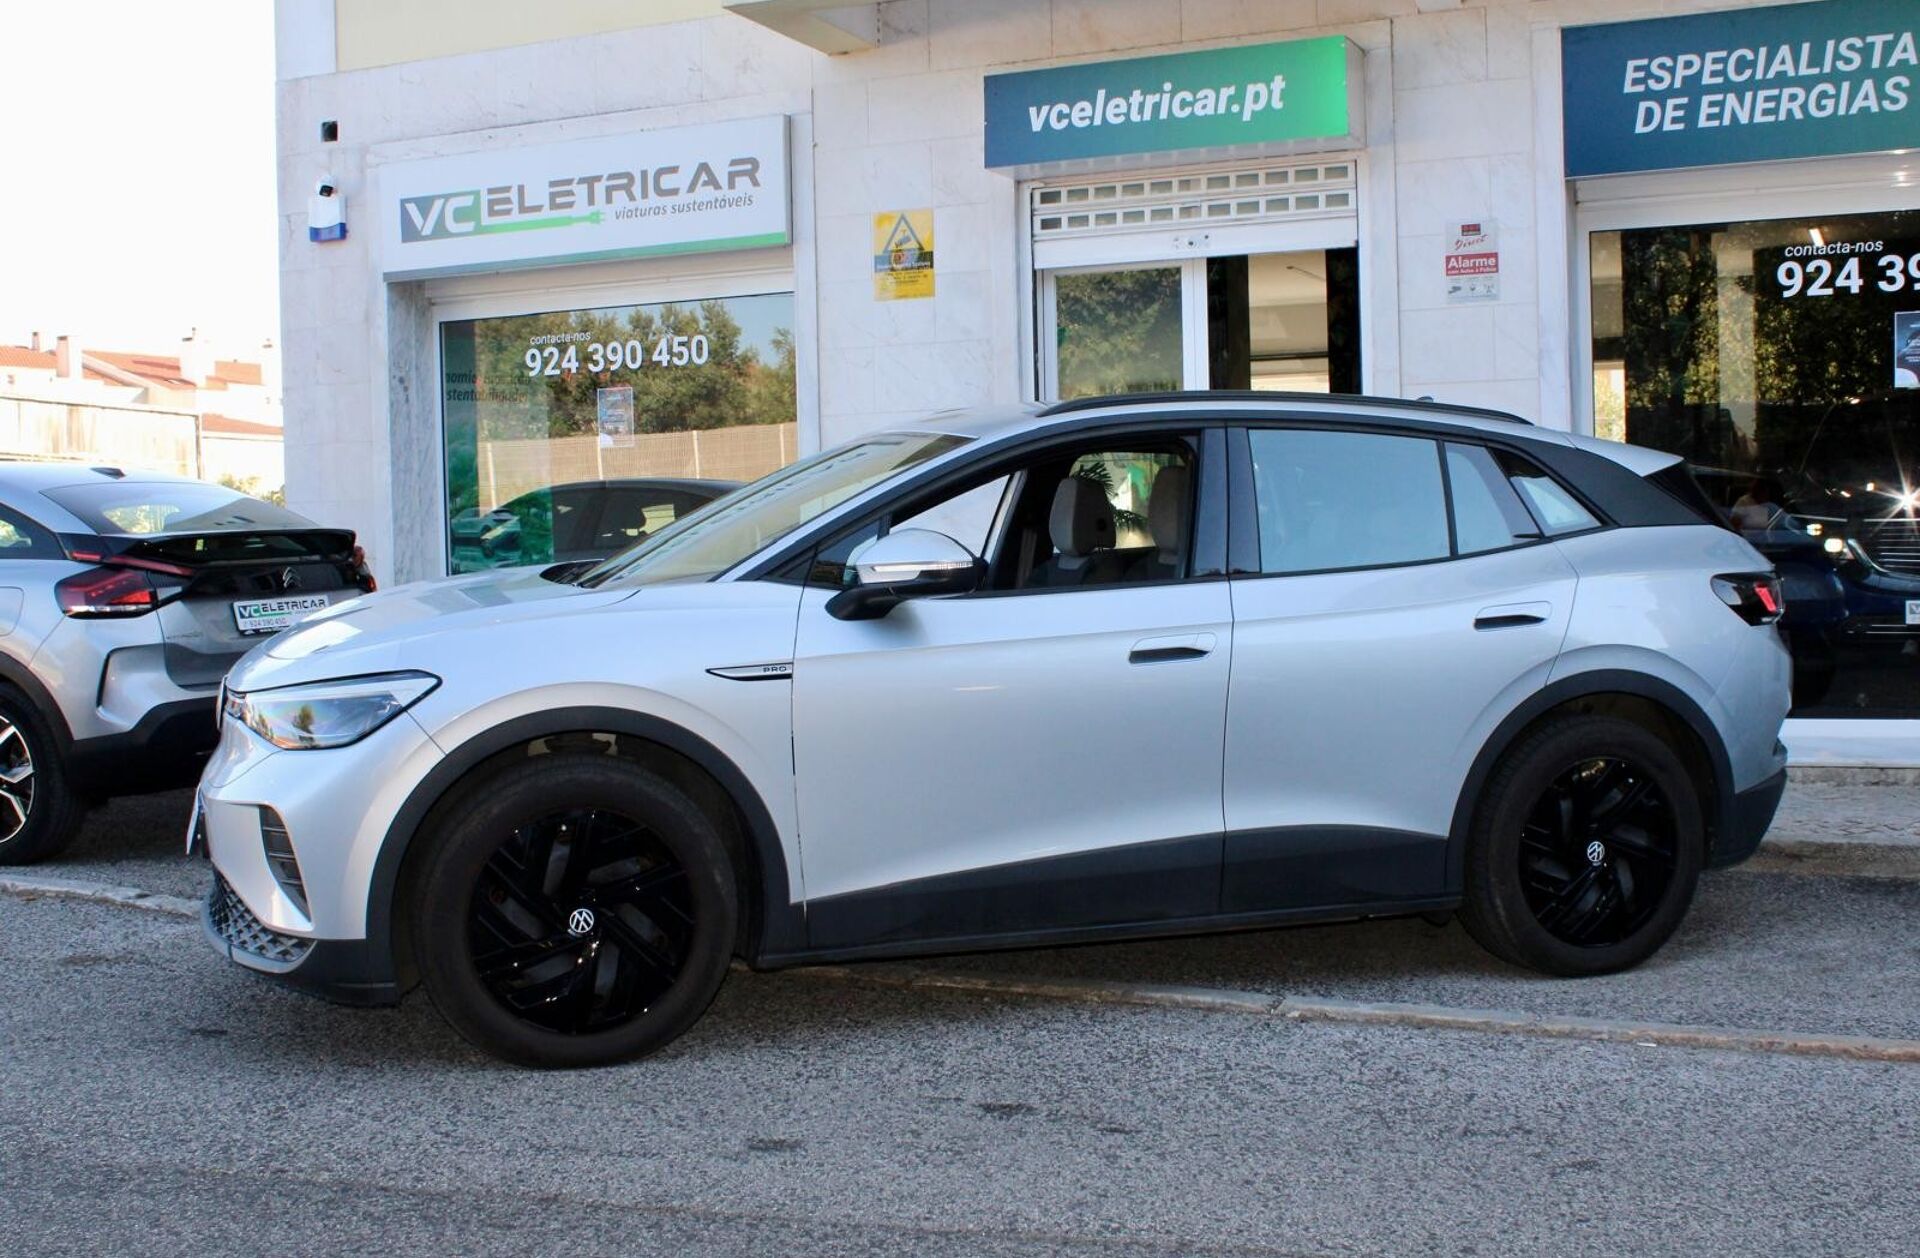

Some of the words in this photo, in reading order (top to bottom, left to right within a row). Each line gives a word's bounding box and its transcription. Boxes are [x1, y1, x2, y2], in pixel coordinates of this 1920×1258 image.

[1623, 31, 1919, 94] ESPECIALISTA
[1028, 75, 1286, 132] vceletricar.pt
[1634, 97, 1688, 134] DE
[1697, 76, 1910, 128] ENERGIAS
[615, 201, 668, 221] viaturas
[670, 192, 755, 217] sustentáveis
[1448, 256, 1496, 268] Alarme
[1784, 240, 1884, 257] contacta-nos
[1777, 256, 1864, 299] 924
[524, 345, 580, 377] 924
[587, 340, 643, 373] 390
[652, 335, 709, 367] 450
[529, 331, 591, 345] contacta-nos
